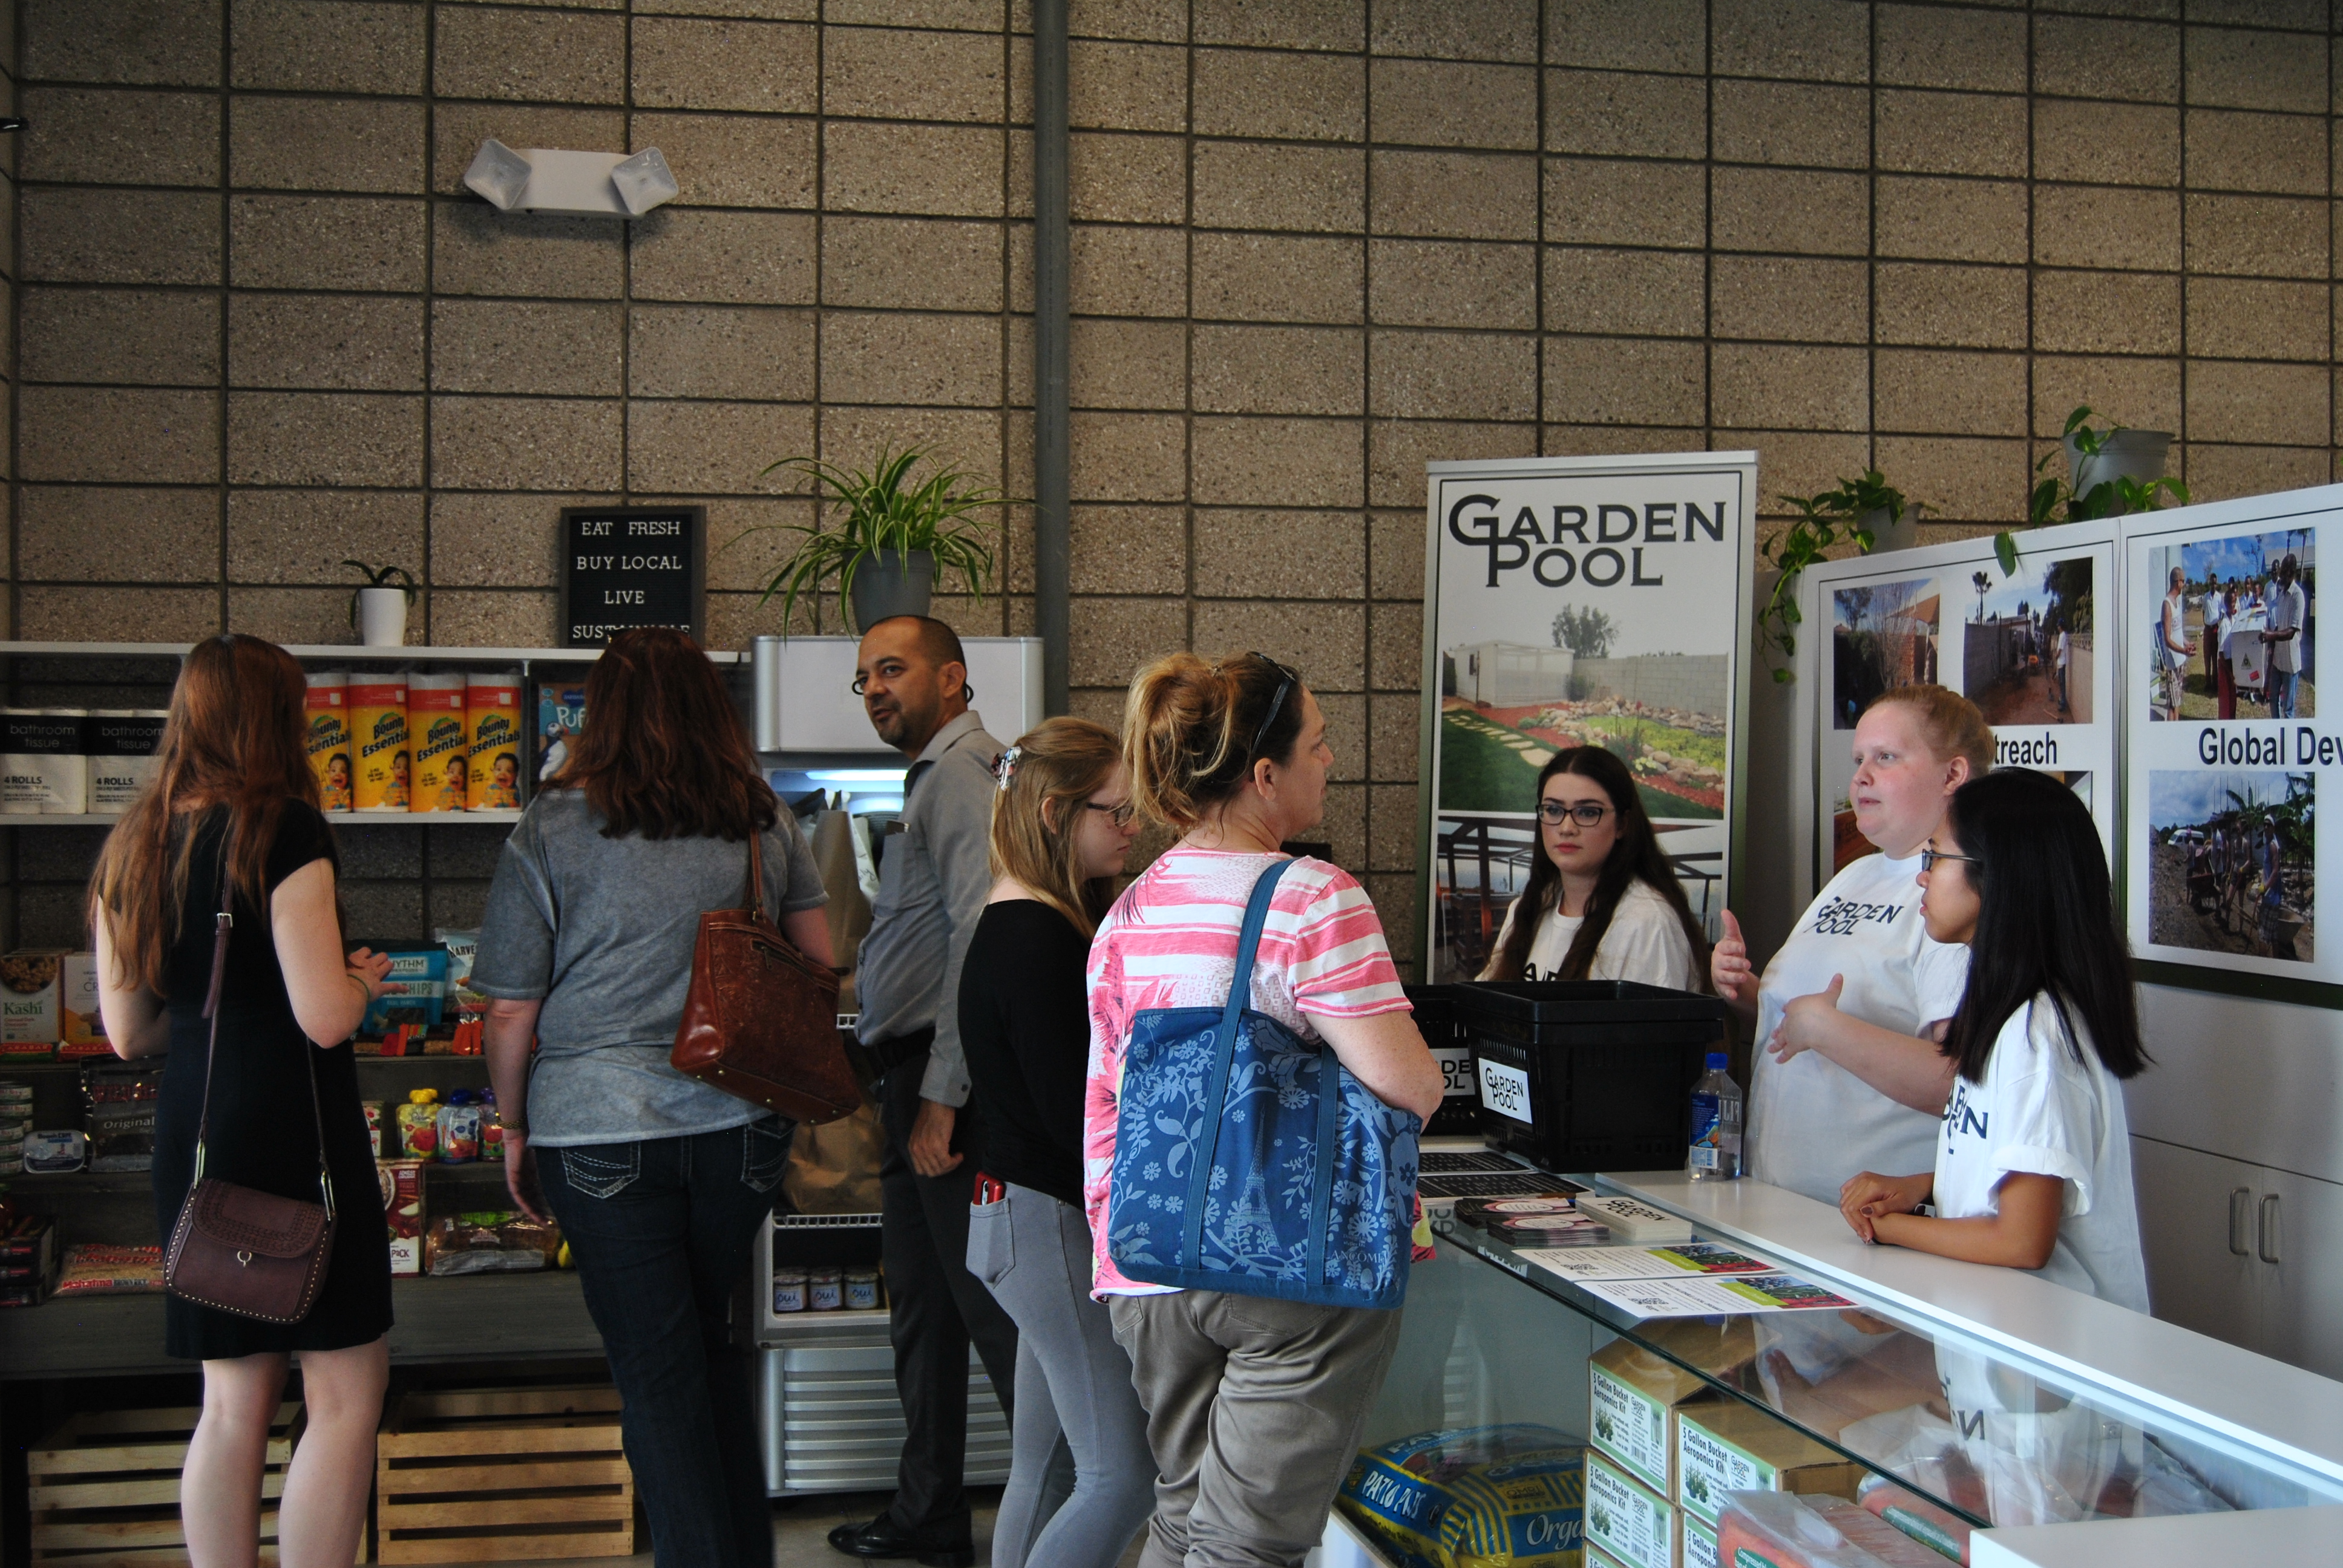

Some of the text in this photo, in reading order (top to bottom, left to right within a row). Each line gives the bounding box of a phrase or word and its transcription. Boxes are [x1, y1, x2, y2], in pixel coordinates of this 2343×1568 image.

[581, 521, 681, 535] EAT FRESH
[1449, 494, 1726, 546] GARDEN
[576, 555, 683, 570] BUY LOCAL
[1486, 537, 1663, 587] POOL
[604, 590, 645, 604] LIVE
[10, 724, 76, 736] bathroom
[101, 725, 164, 737] bathroom
[373, 716, 405, 740] Bounty
[427, 721, 461, 745] Bounty
[477, 718, 510, 741] Bounty
[25, 737, 60, 748] tissue
[116, 739, 151, 750] tissue
[1994, 731, 2057, 765] treach
[2199, 727, 2286, 765] Global
[104, 777, 134, 786] ROLLS
[1818, 896, 1904, 924] GARDEN
[407, 982, 433, 995] HIPS
[4, 1000, 44, 1015] Kashi
[1485, 1067, 1524, 1098] GARDEN
[1492, 1086, 1518, 1111] POOL
[103, 1116, 156, 1129] Original
[1593, 1373, 1629, 1403] 5 Gallon Bucket
[1594, 1385, 1618, 1410] Aeroponics
[1683, 1426, 1728, 1463] 5 Gallon Bucket
[1683, 1440, 1714, 1469] Aeroponics
[1715, 1457, 1724, 1474] Kit
[1362, 1470, 1401, 1509] PATIO
[1590, 1466, 1629, 1500] 5 Gallon Bucket
[1590, 1478, 1627, 1511] Aeroponics Kit
[1687, 1529, 1691, 1541] 5
[1693, 1533, 1711, 1555] Gallon
